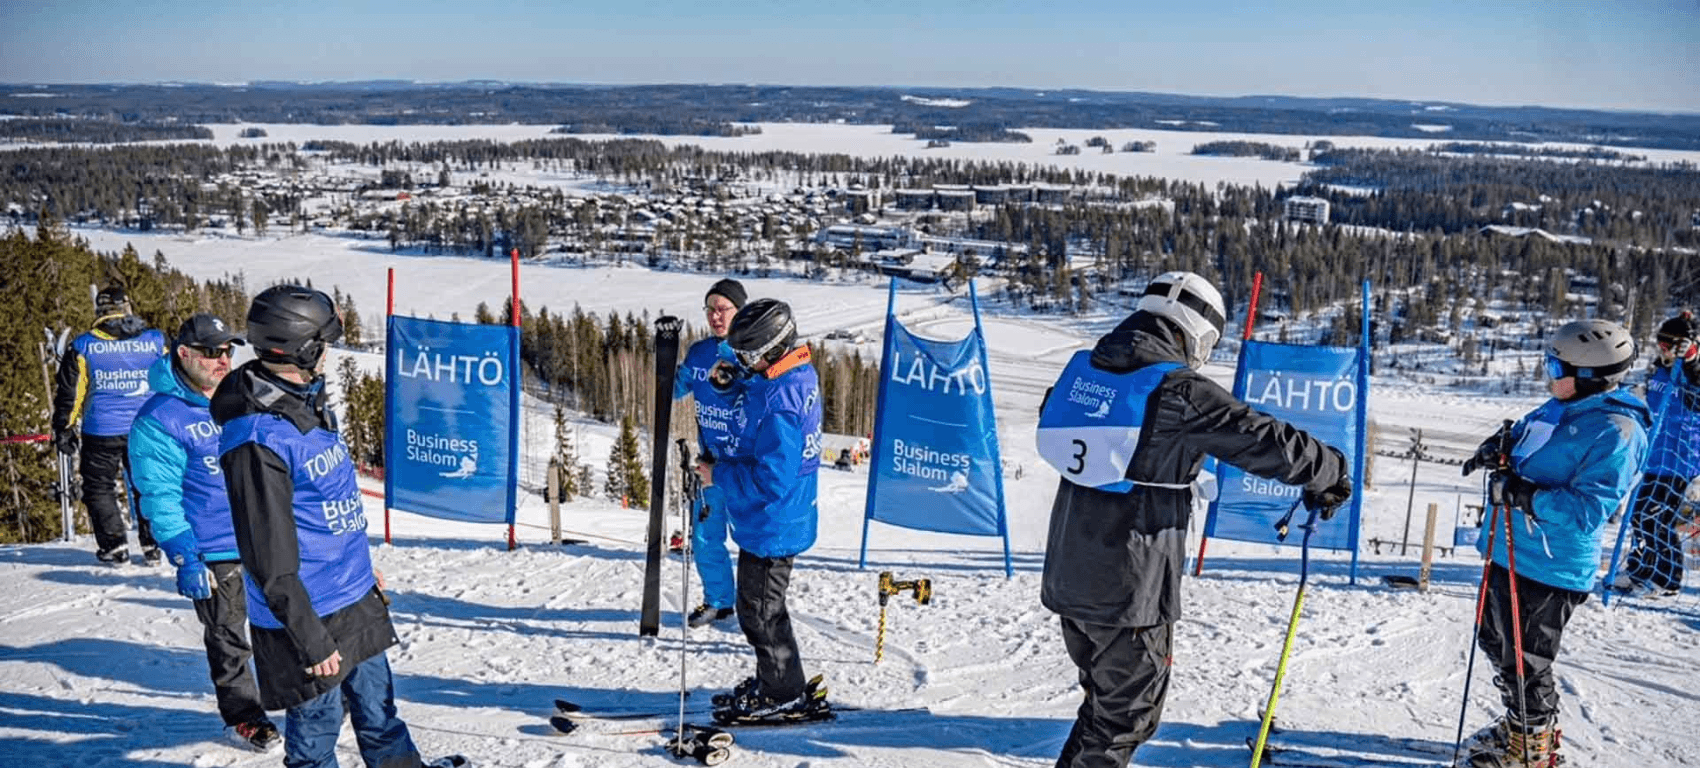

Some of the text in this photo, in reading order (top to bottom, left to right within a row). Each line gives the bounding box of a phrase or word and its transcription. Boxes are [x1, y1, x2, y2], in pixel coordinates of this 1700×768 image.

[95, 368, 149, 380] Business
[398, 345, 503, 386] LÄHTÖ
[892, 350, 986, 395] LÄHTÖ
[95, 378, 138, 390] Slalom
[1072, 376, 1118, 399] Business
[1245, 370, 1355, 412] LÄHTÖ
[1068, 389, 1100, 408] Slalom
[407, 429, 478, 453] Business
[893, 438, 970, 468] Business
[407, 446, 458, 467] Slalom
[893, 456, 947, 481] Slalom
[1067, 438, 1087, 475] 3
[1242, 476, 1301, 498] Slalom
